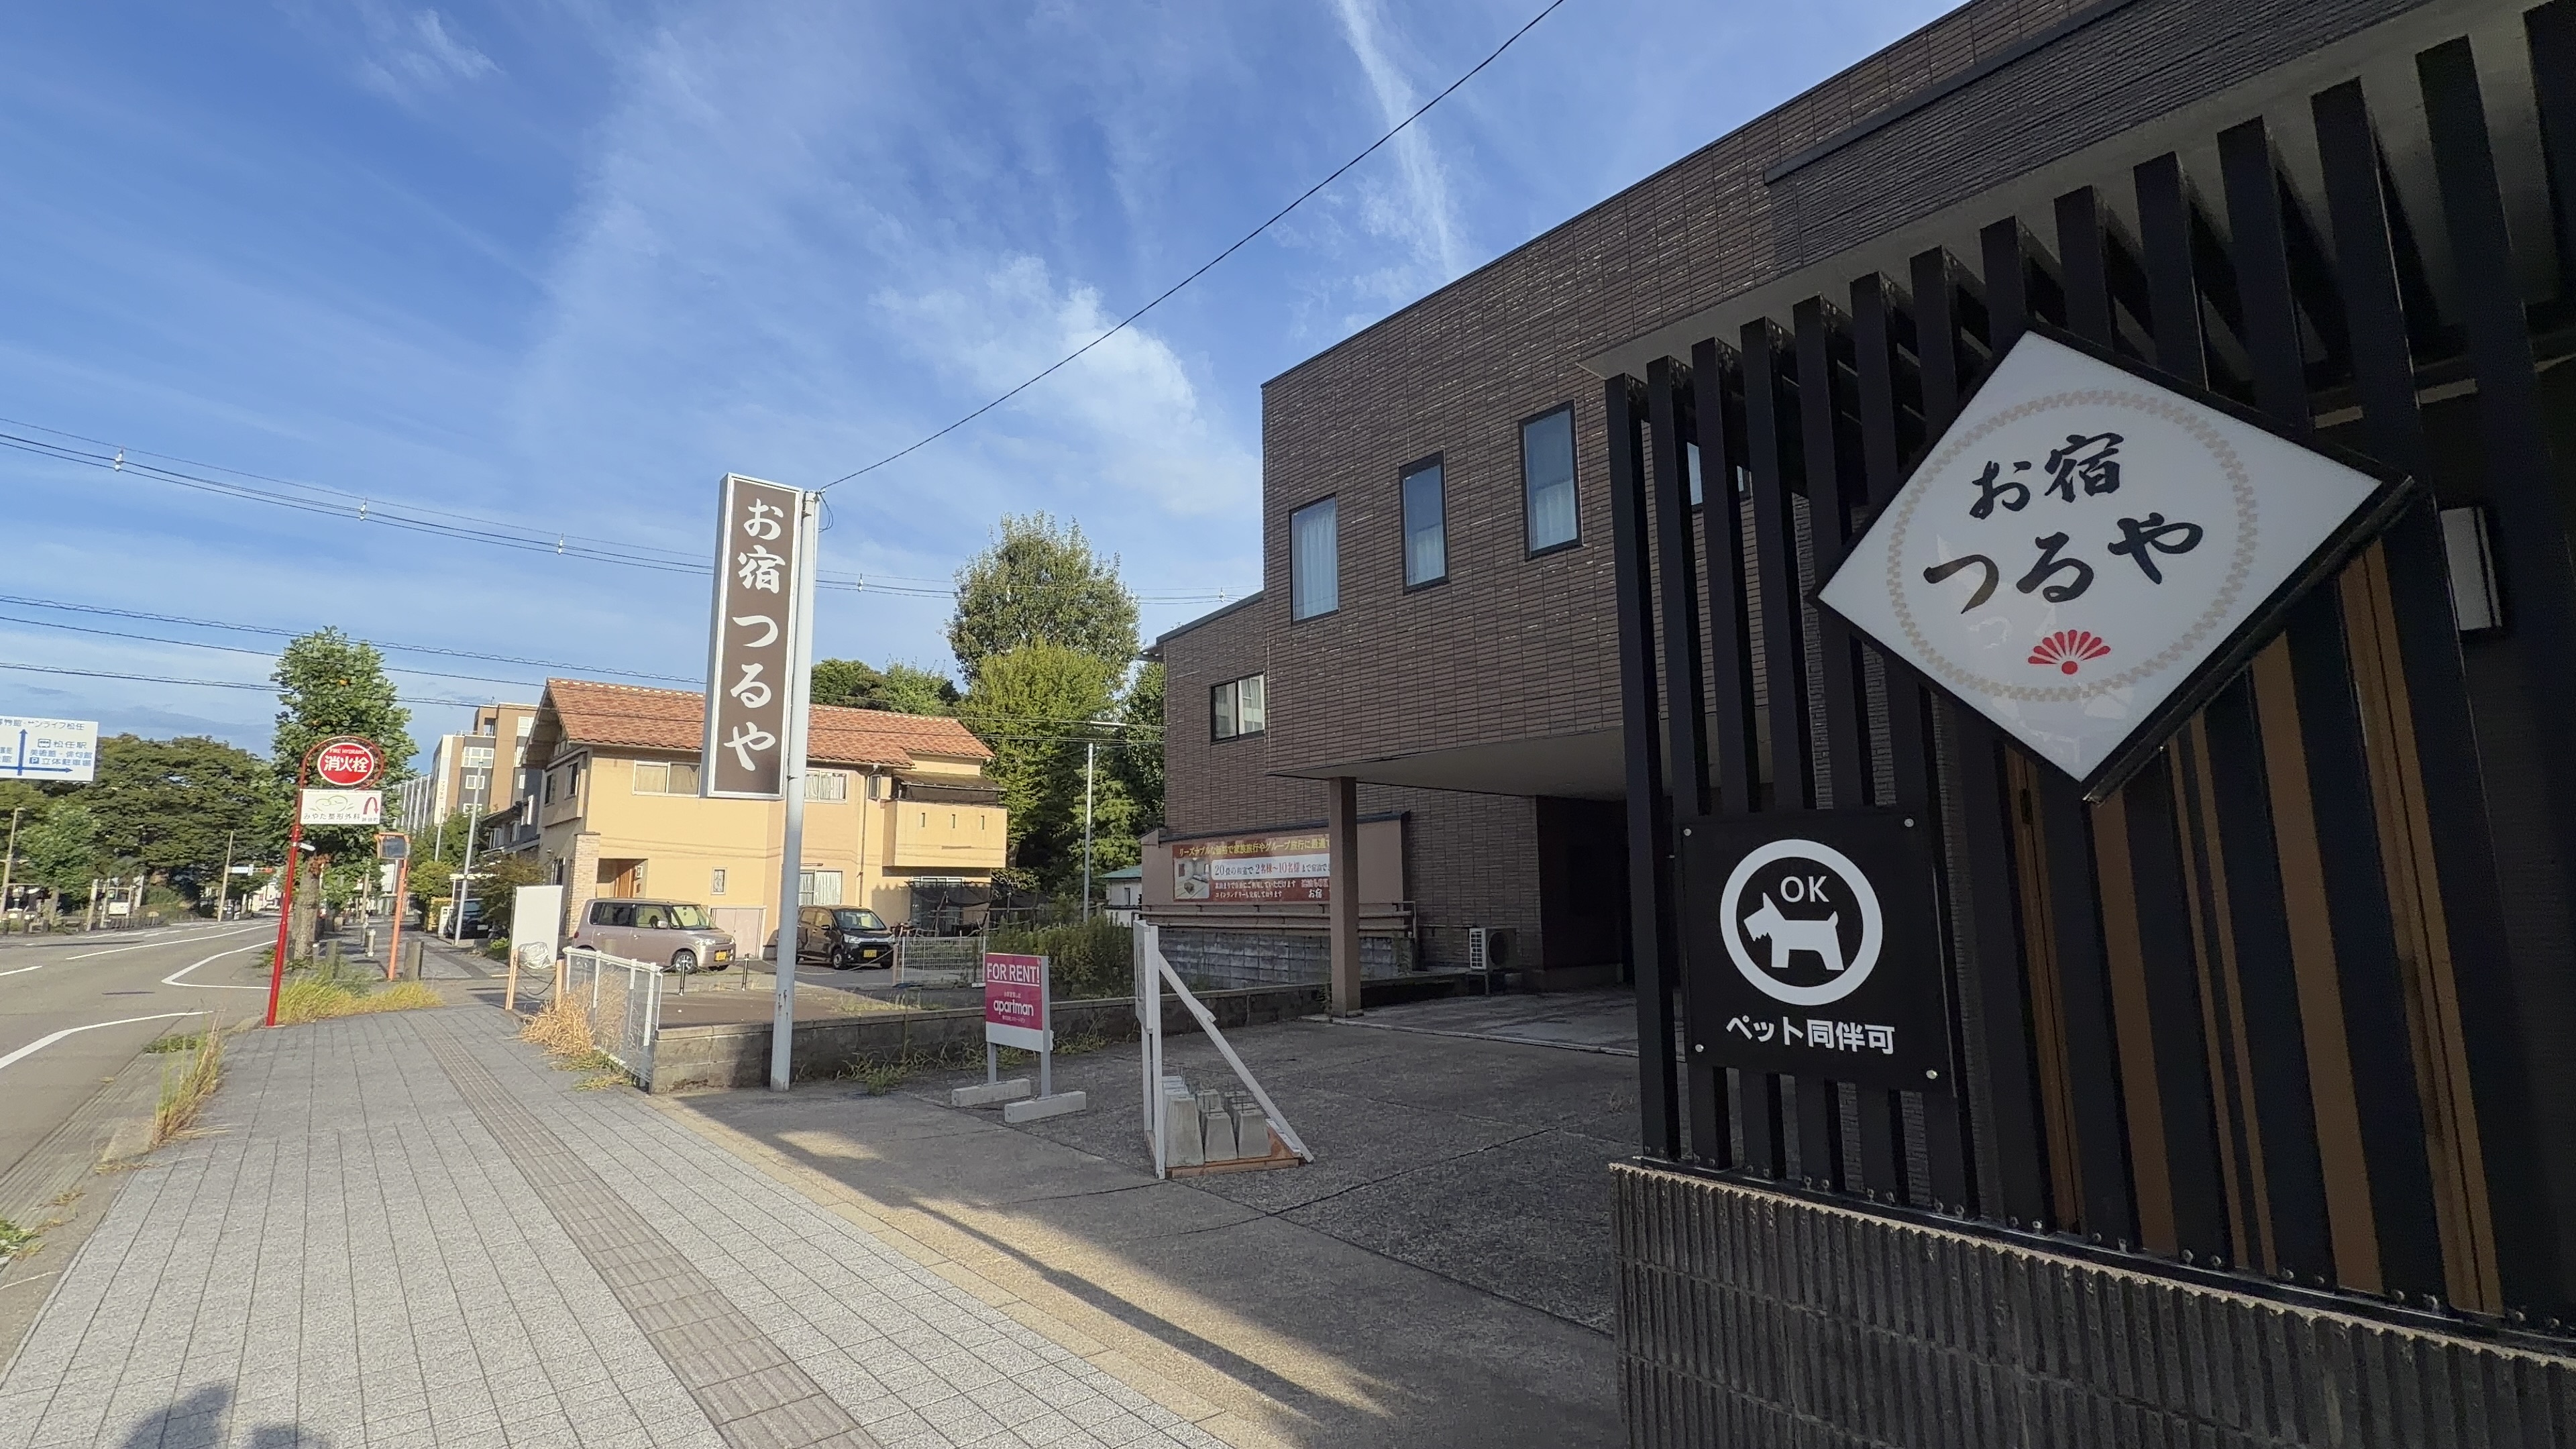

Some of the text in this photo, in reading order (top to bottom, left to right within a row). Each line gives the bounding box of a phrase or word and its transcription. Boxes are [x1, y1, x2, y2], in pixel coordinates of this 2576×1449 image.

[1970, 433, 2124, 519] お宿
[1923, 512, 2203, 614] つるや
[54, 741, 87, 749] 松任駅
[323, 755, 369, 772] 消火栓
[1780, 876, 1829, 902] OK
[987, 963, 1040, 983] FOR RENT!
[994, 999, 1034, 1016] apartman
[1726, 1015, 1895, 1055] ペット同伴可
